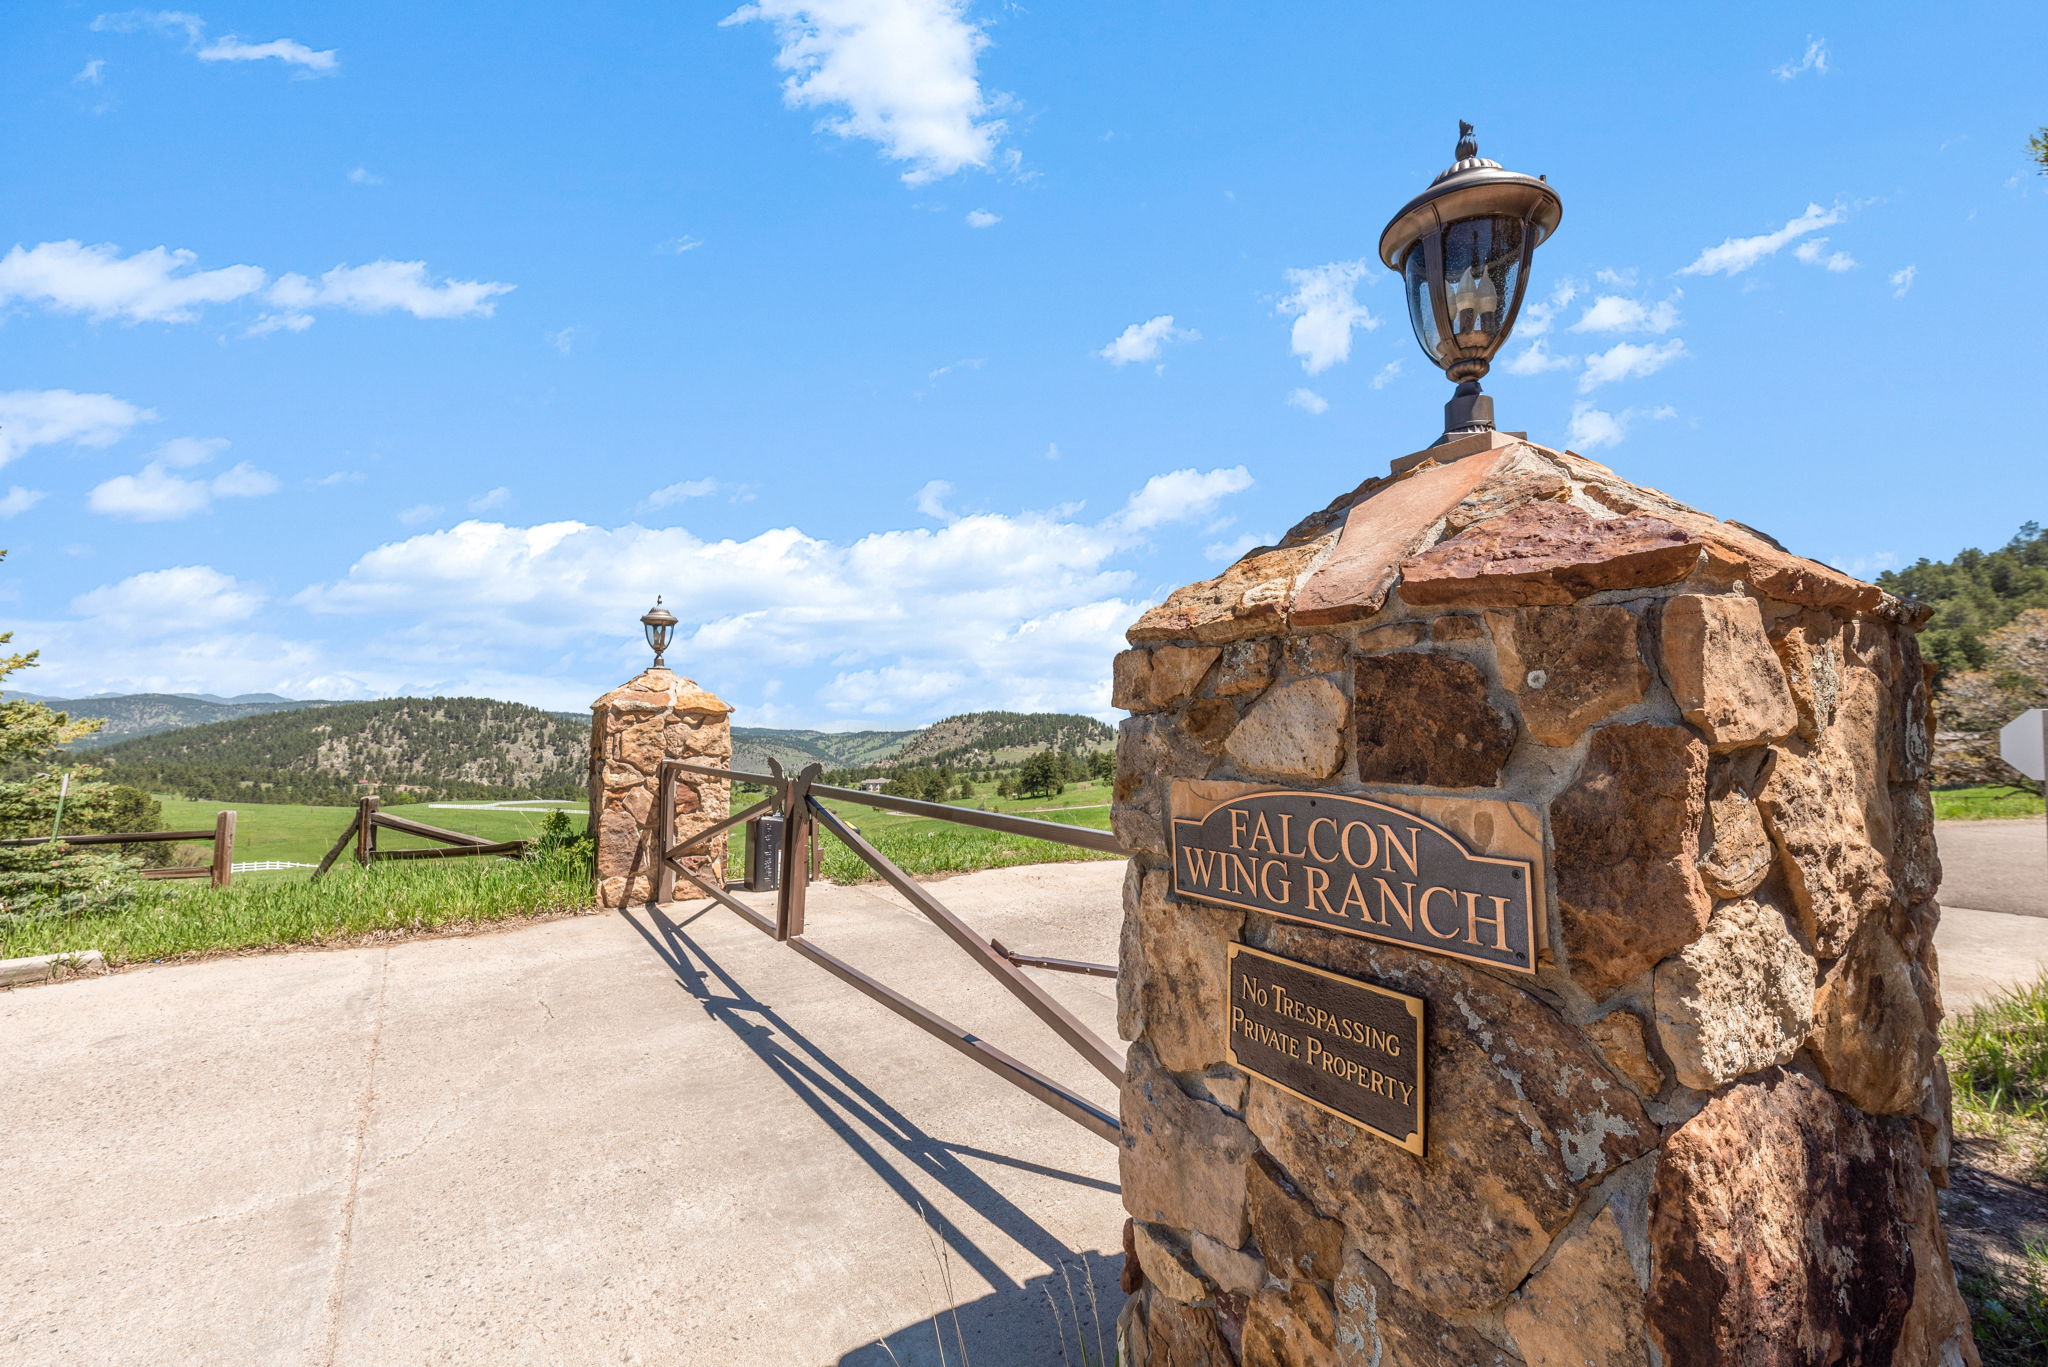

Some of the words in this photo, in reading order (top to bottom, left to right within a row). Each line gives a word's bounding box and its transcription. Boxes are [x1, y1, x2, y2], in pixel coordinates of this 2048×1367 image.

[1228, 808, 1422, 877] FALCON
[1182, 846, 1293, 904] WING
[1303, 865, 1514, 952] RANCH
[1232, 1005, 1301, 1059] PRIVATE
[1306, 1036, 1414, 1106] PROPERTY
[1242, 974, 1268, 1007] NO
[1271, 984, 1401, 1057] TRESPASSING
